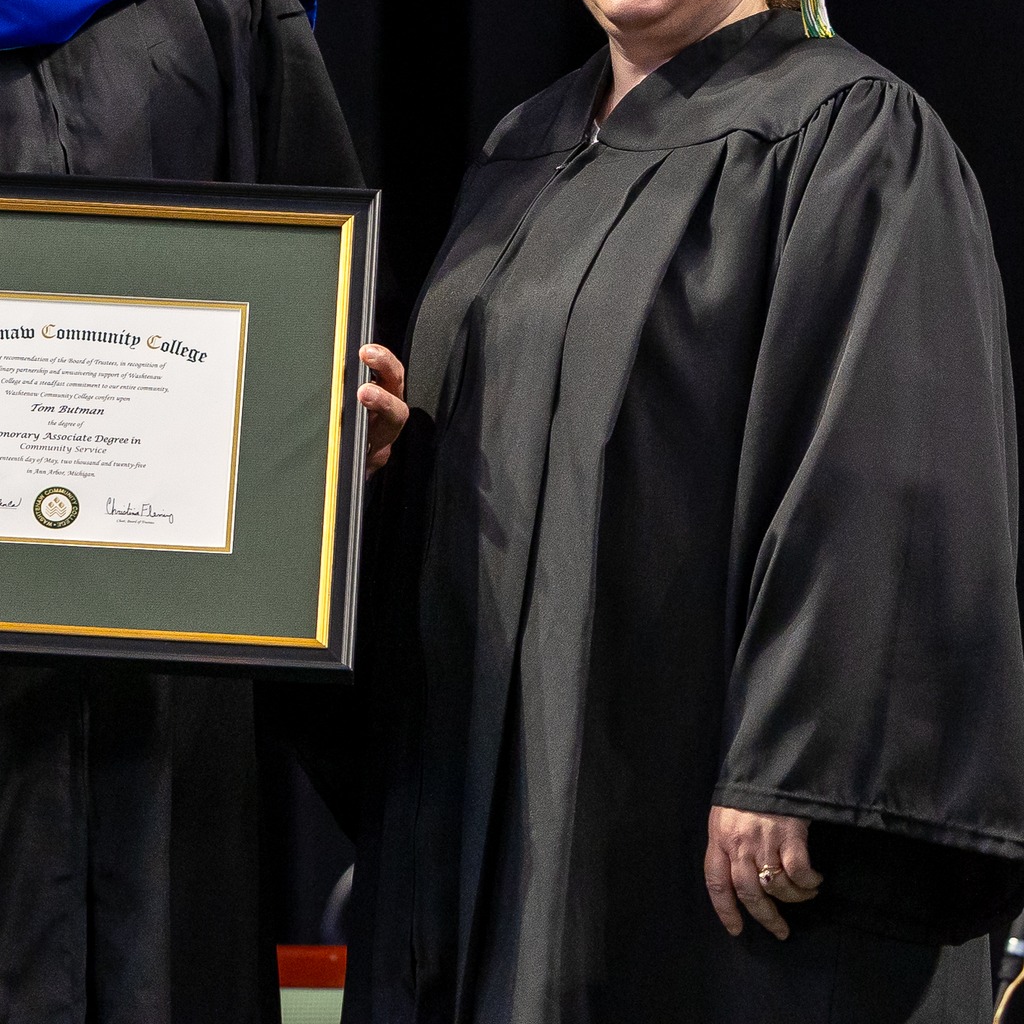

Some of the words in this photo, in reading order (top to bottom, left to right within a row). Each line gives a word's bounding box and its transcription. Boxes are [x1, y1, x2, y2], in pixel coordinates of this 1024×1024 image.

[41, 324, 141, 350] Community
[146, 335, 208, 363] College
[3, 355, 49, 363] recommendation
[86, 358, 94, 366] of
[127, 361, 158, 369] recognition
[15, 367, 48, 375] partnership
[0, 377, 21, 385] College
[5, 389, 39, 397] Washtenaw
[40, 392, 73, 400] Community
[73, 393, 94, 401] College
[94, 394, 115, 402] confers
[30, 403, 55, 413] Tom
[58, 405, 105, 415] Butman
[57, 420, 76, 428] degree
[42, 432, 92, 443] Associate
[94, 434, 129, 445] Degree
[130, 436, 142, 445] in
[19, 442, 72, 454] Community
[74, 445, 107, 454] Service
[24, 456, 36, 464] day
[36, 456, 44, 464] of
[73, 458, 101, 466] thousand
[113, 461, 147, 469] twenty-five
[44, 488, 78, 505] COMMUNITY
[34, 493, 53, 527] WASHTENAW
[56, 506, 79, 527] COLLEGE
